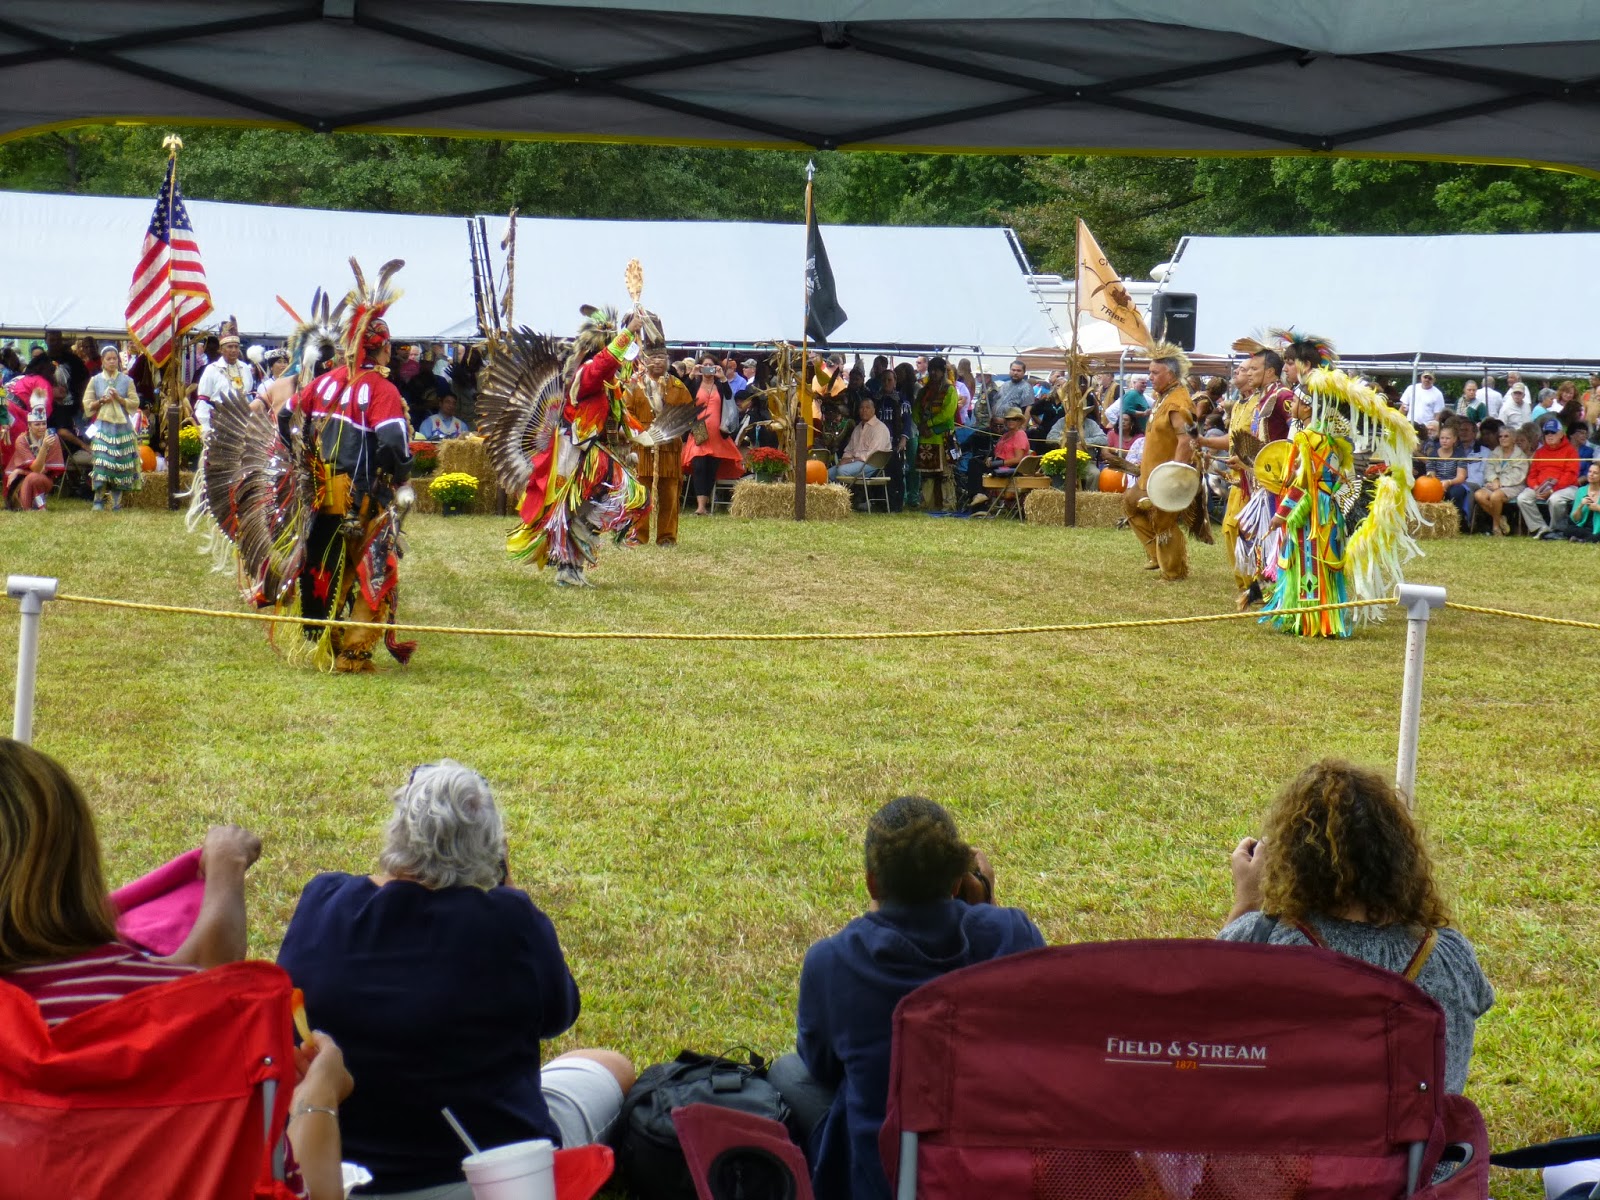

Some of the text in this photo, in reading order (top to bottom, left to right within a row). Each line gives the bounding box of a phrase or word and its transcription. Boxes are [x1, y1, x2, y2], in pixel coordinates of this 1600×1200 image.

[1100, 305, 1125, 324] TRIBE
[1107, 1037, 1267, 1060] FIELD & STREAM
[1176, 1060, 1197, 1070] 1871
